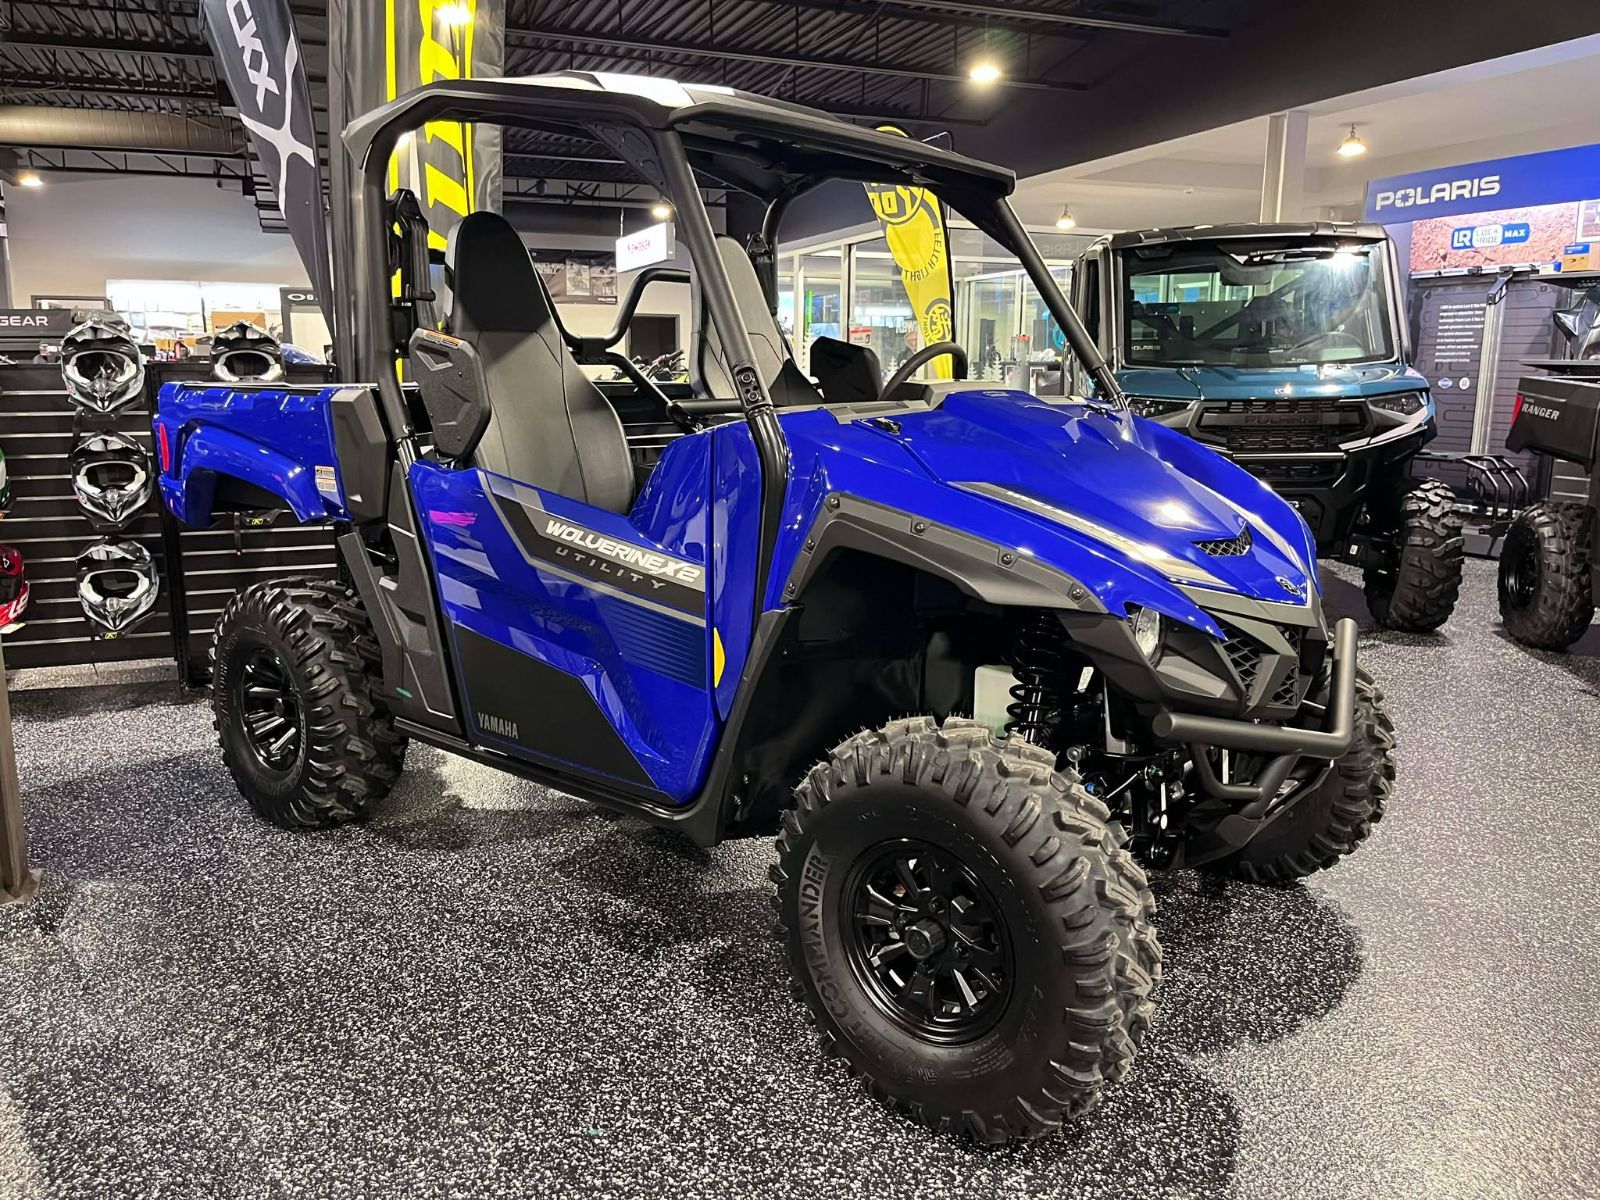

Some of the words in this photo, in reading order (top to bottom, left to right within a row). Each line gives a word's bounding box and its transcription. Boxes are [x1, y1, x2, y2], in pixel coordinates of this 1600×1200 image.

[1375, 175, 1500, 211] POLARIS
[1504, 228, 1526, 238] MAX
[0, 315, 49, 327] GEAR
[1521, 403, 1560, 420] RANGER
[555, 547, 667, 590] UTILITY
[477, 711, 519, 740] YAMAHA
